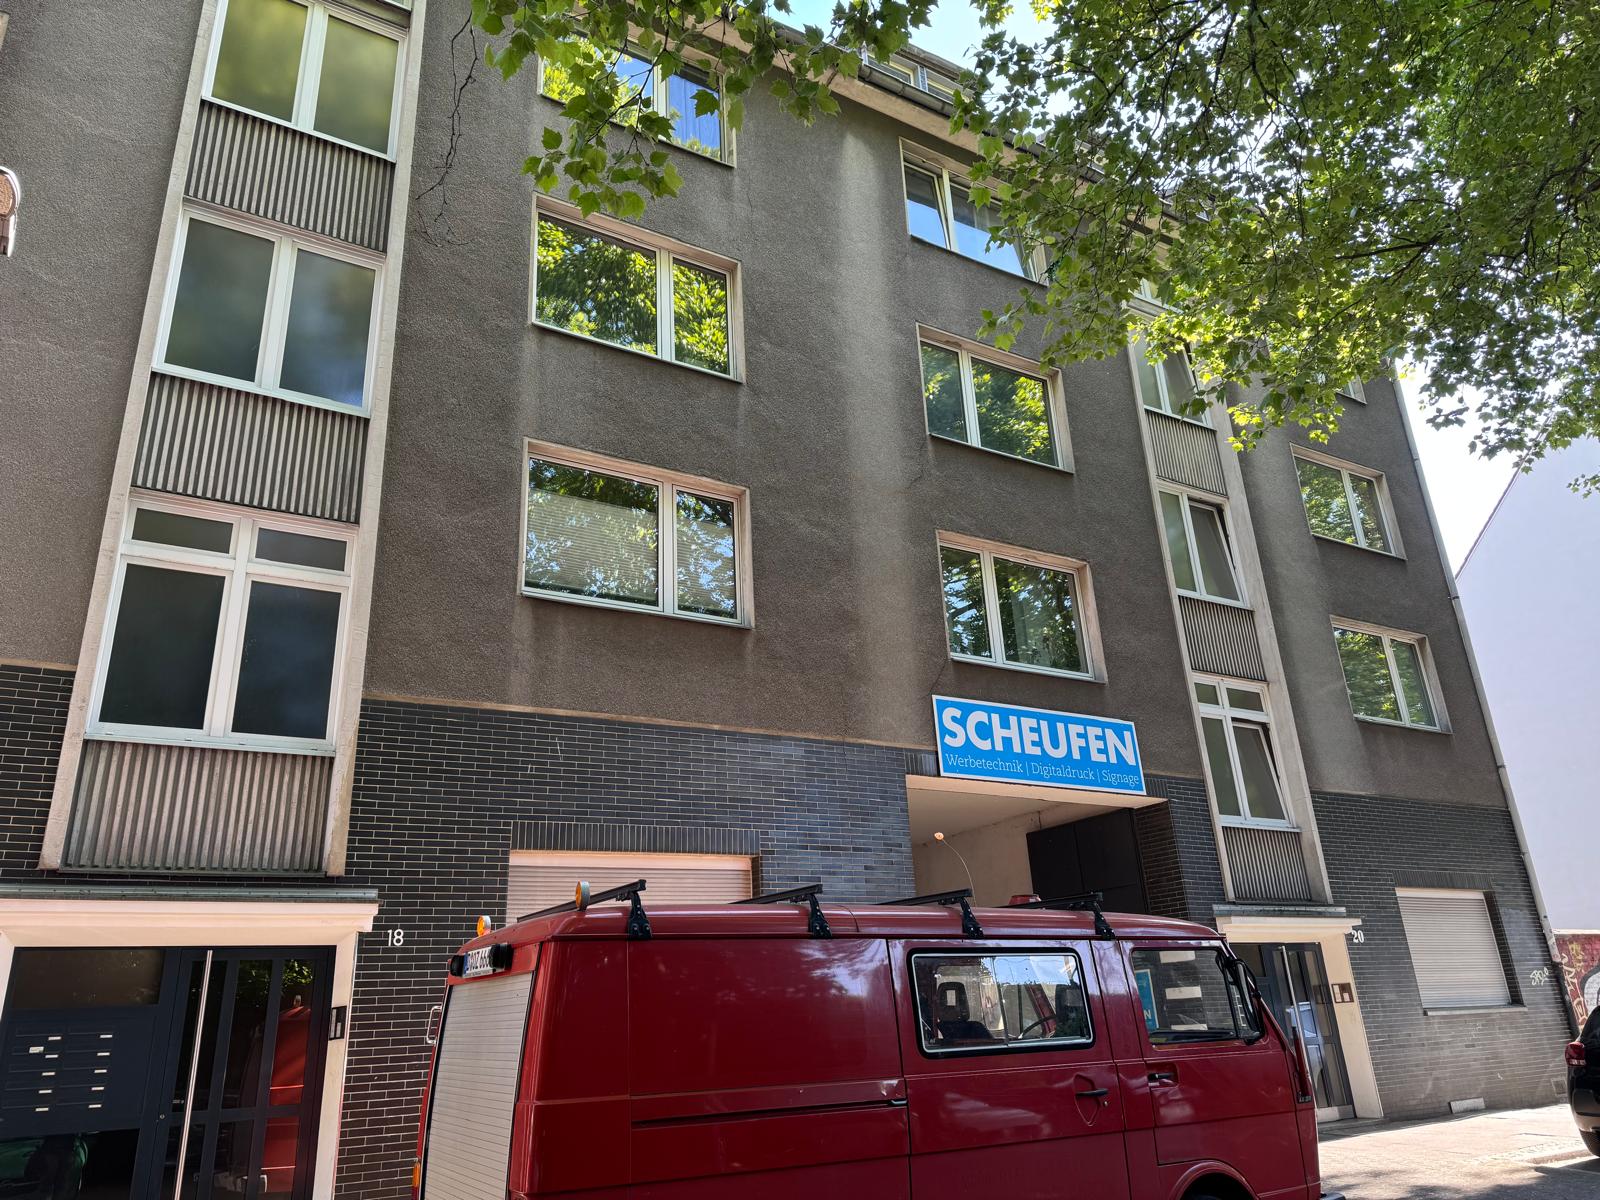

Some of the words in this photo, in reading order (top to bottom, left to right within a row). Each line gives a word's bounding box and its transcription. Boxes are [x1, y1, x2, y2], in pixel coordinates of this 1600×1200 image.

[942, 707, 1137, 766] SCHEUFEN
[945, 753, 1024, 773] Werbetechnik
[1031, 762, 1095, 780] Digitaldruck
[1102, 769, 1140, 785] Signage
[387, 928, 404, 947] 18
[1351, 929, 1365, 943] 20
